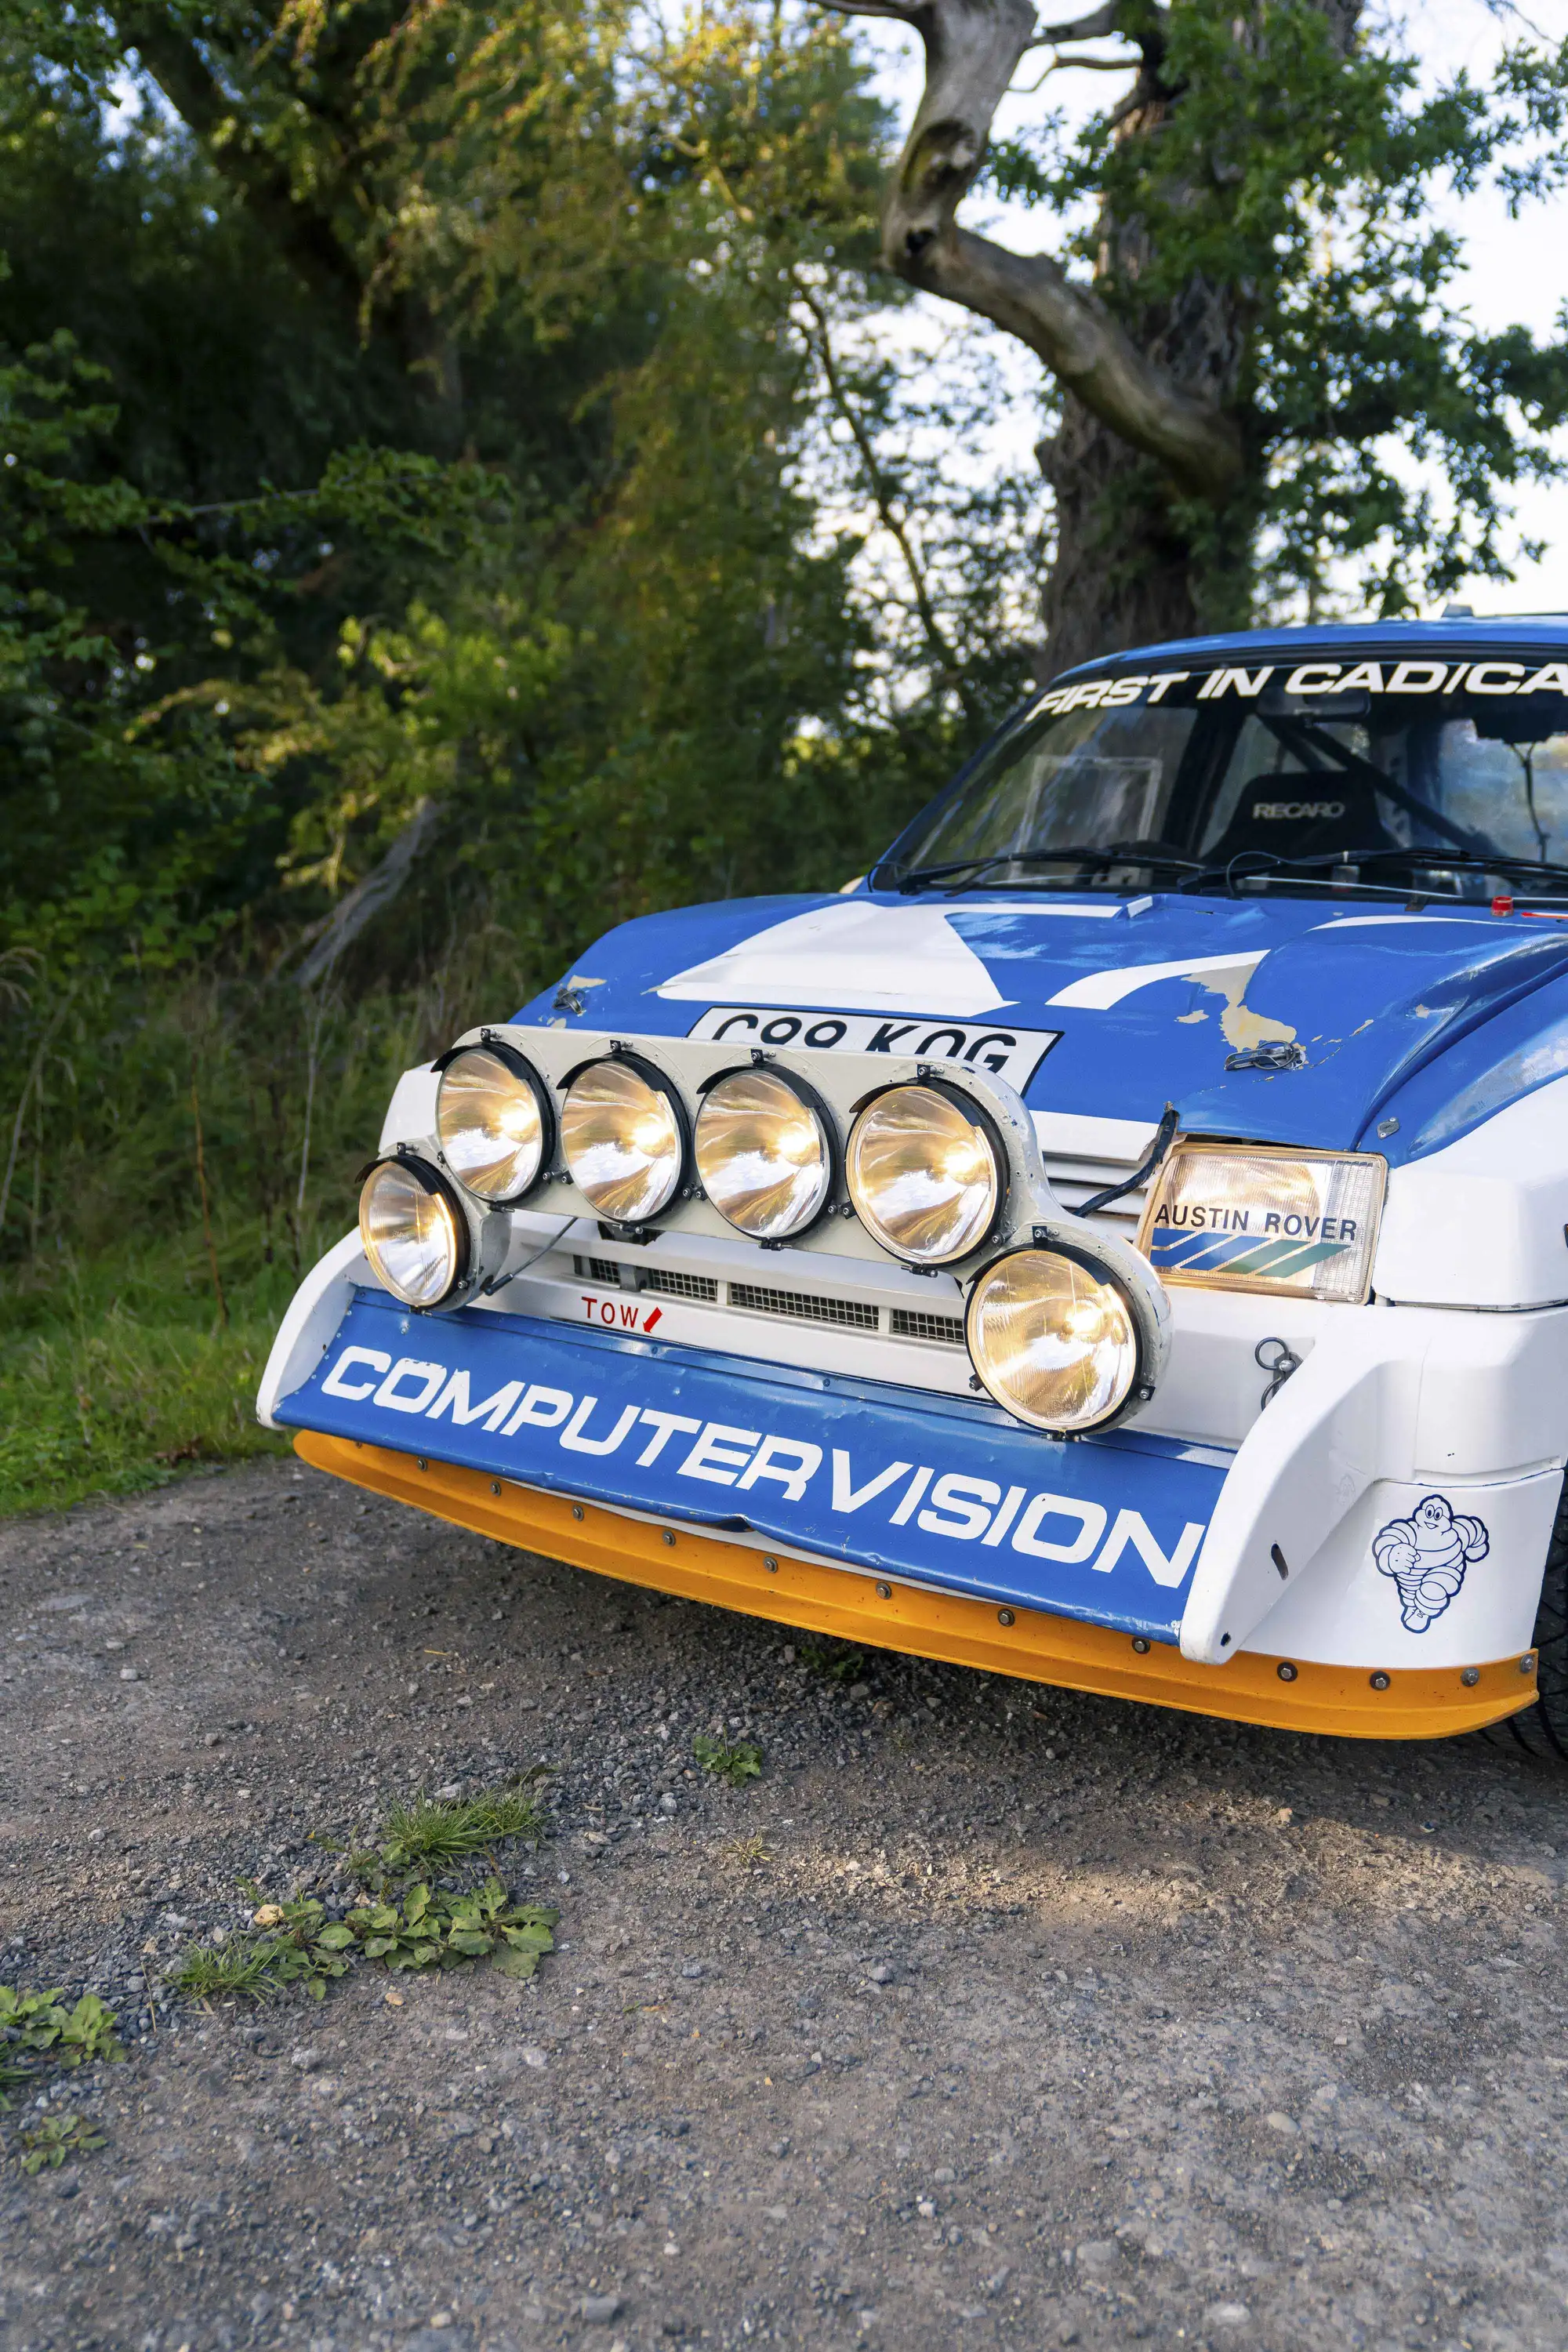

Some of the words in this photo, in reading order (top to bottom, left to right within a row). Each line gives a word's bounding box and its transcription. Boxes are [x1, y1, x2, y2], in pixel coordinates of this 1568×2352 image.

[1025, 671, 1190, 722] FIRST
[1196, 666, 1275, 699] IN
[1253, 801, 1345, 819] RECARO
[1154, 1203, 1250, 1231] AUSTIN
[1265, 1212, 1357, 1240] ROVER
[581, 1296, 639, 1328] TOW
[321, 1345, 1206, 1589] COMPUTERVISION
